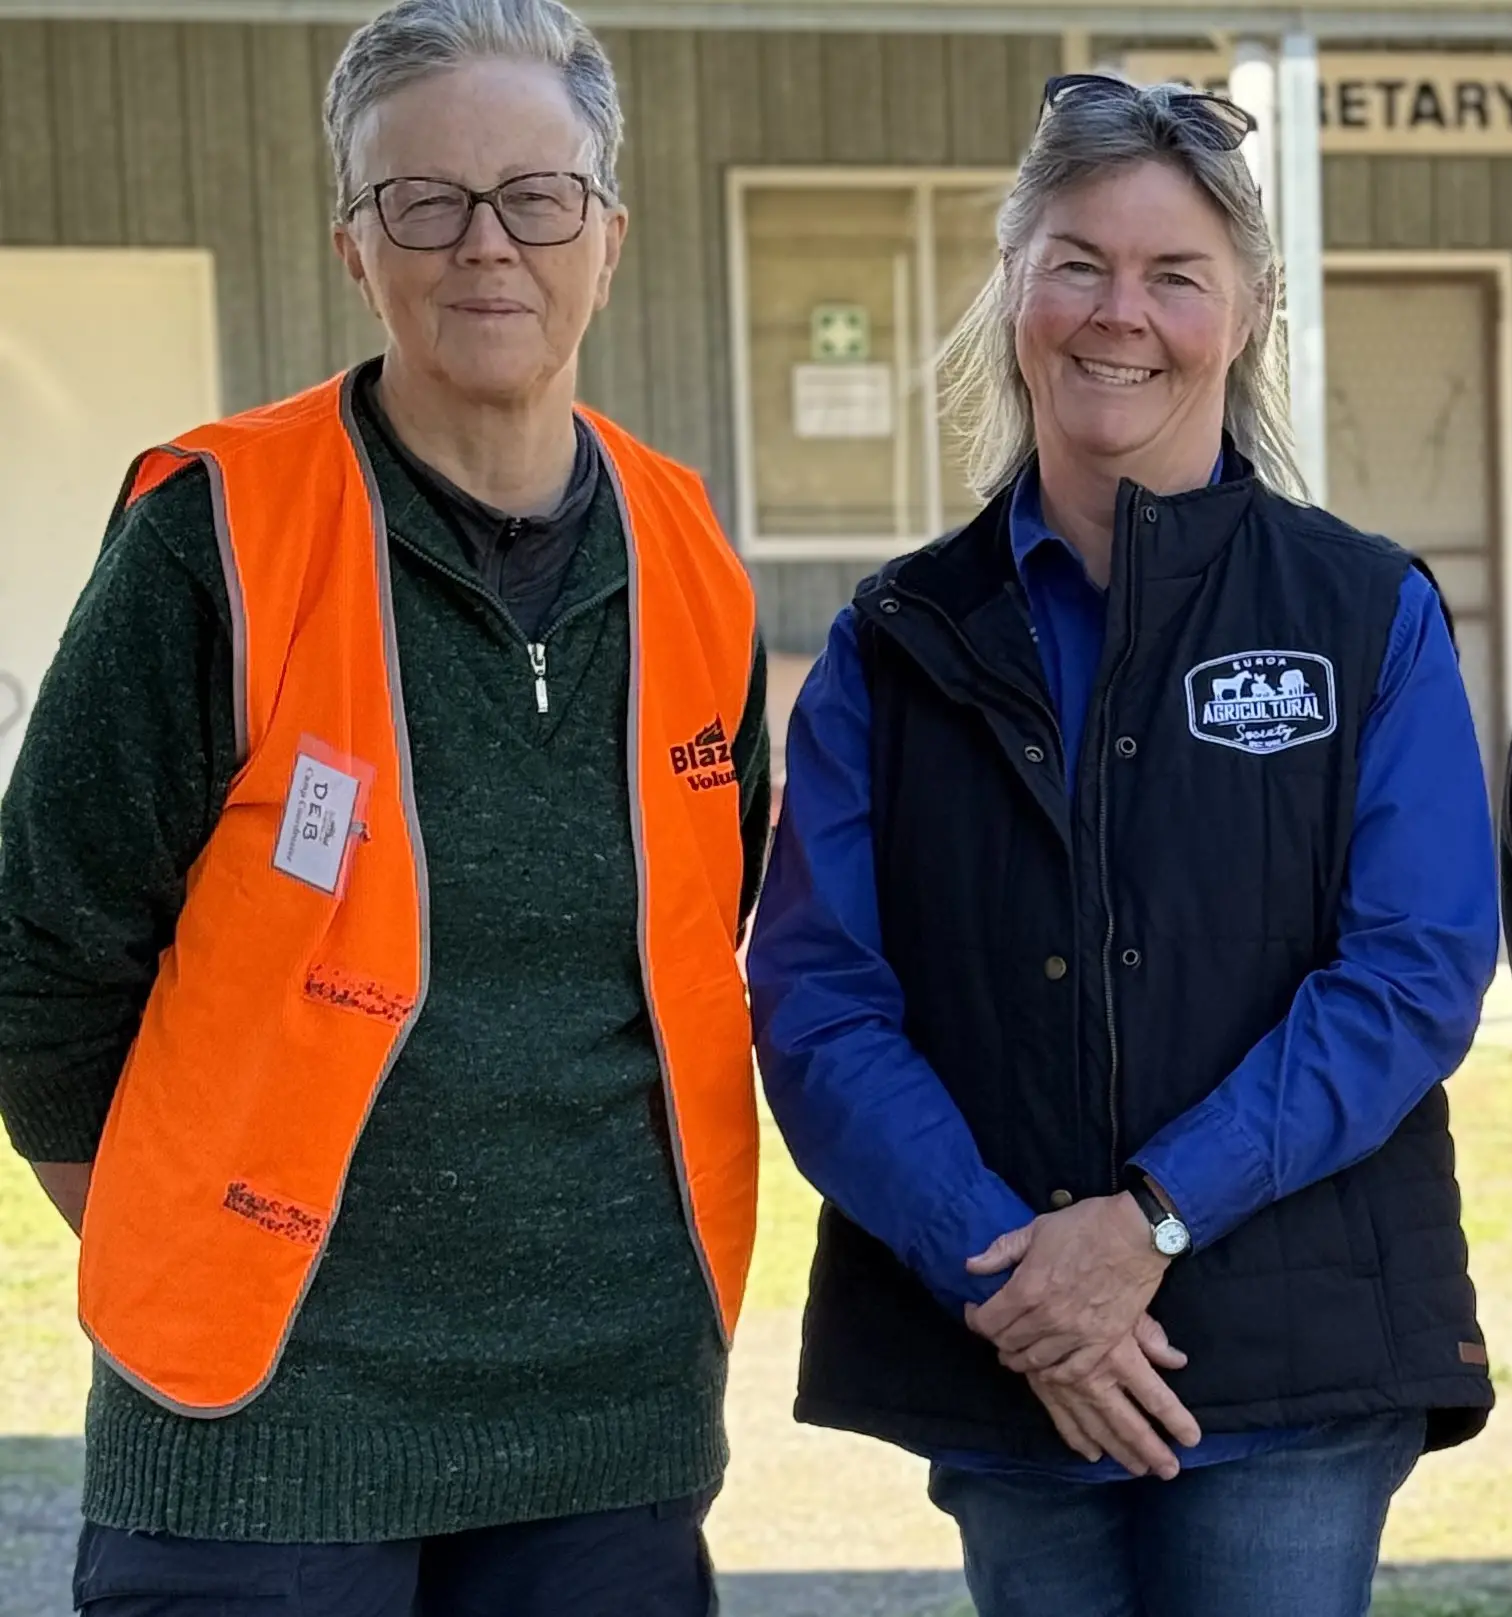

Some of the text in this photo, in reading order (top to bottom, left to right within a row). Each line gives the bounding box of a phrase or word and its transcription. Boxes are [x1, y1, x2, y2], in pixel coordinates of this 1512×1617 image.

[1232, 657, 1287, 670] EUROA
[1203, 697, 1323, 725] AGRICULTURAL
[1234, 723, 1297, 741] Society
[670, 742, 731, 775] Blaz
[302, 782, 328, 841] DEB
